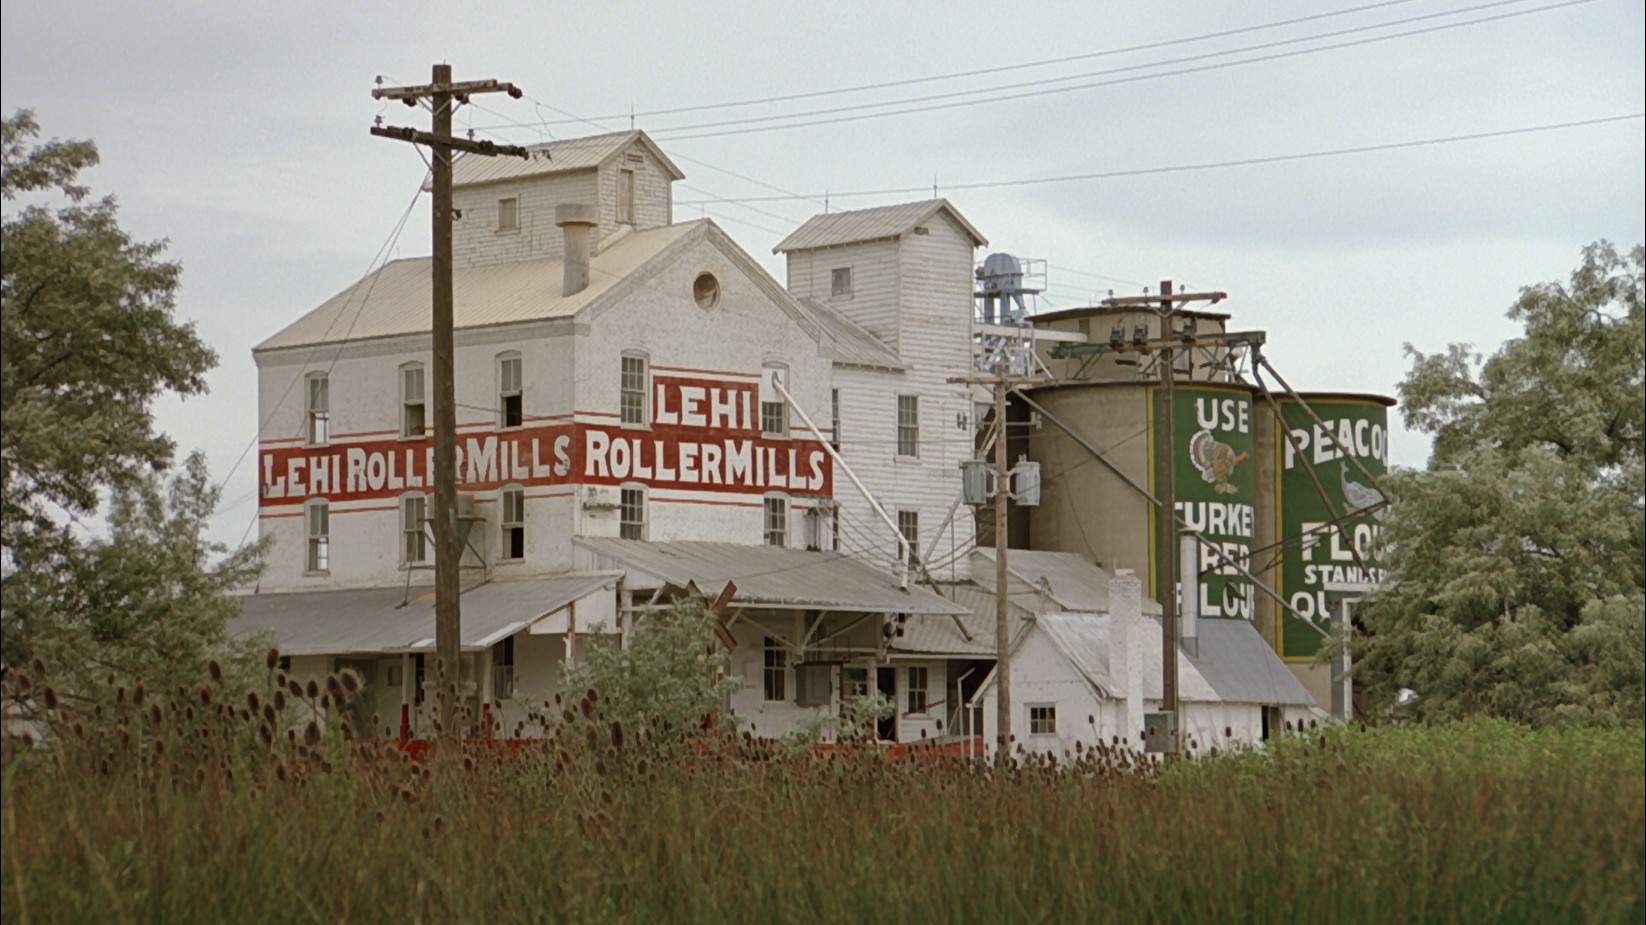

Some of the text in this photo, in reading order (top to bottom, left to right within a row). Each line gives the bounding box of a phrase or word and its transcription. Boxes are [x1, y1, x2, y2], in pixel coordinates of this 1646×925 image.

[655, 383, 752, 430] LEHI
[1197, 397, 1249, 434] USE
[263, 454, 341, 498] LEHI
